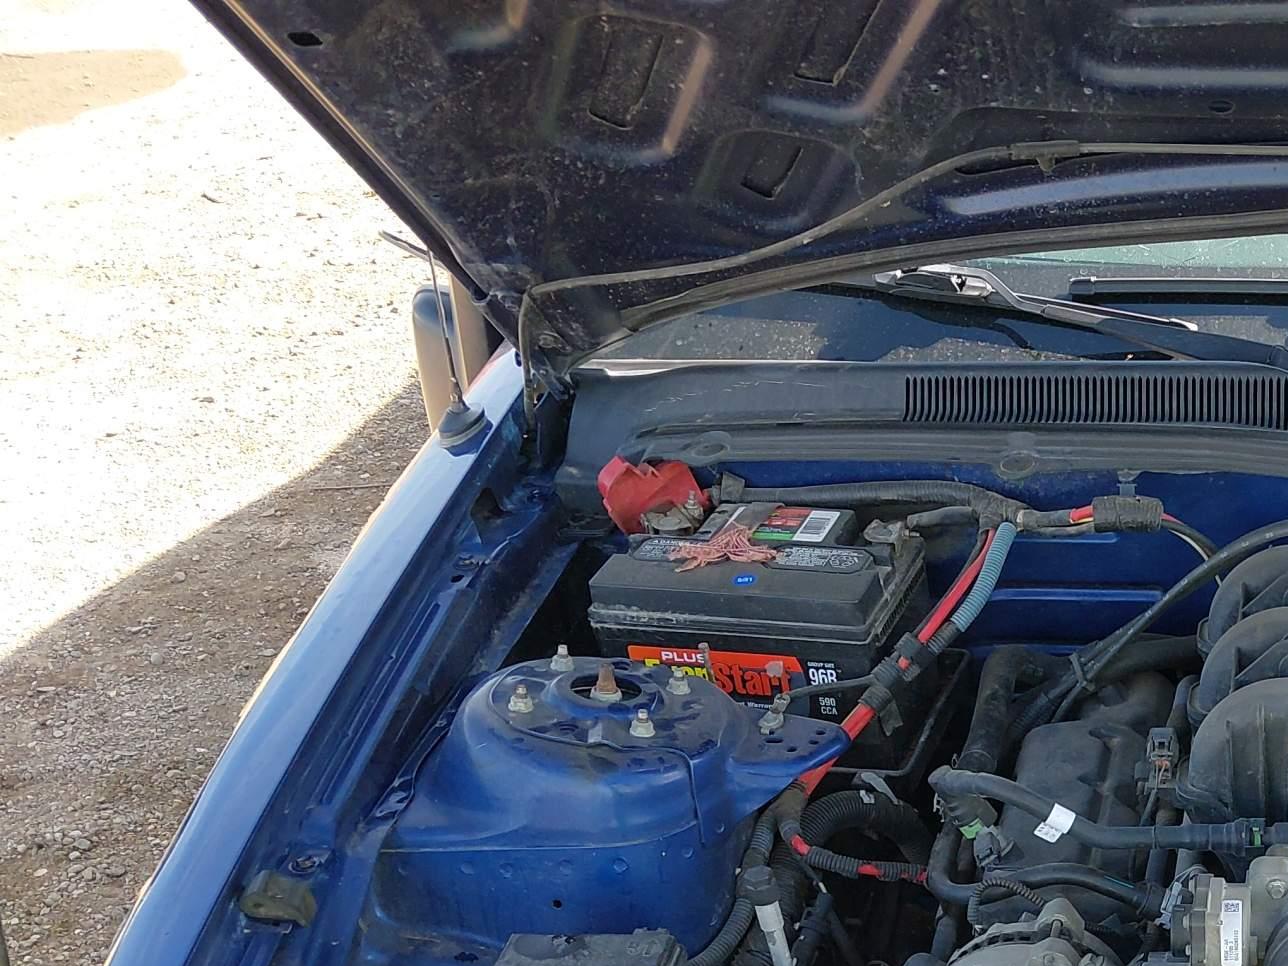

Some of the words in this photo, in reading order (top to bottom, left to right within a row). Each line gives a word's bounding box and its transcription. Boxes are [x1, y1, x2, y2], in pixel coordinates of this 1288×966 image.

[660, 650, 705, 663] PLUS
[819, 697, 836, 706] 590
[821, 706, 838, 716] CCA
